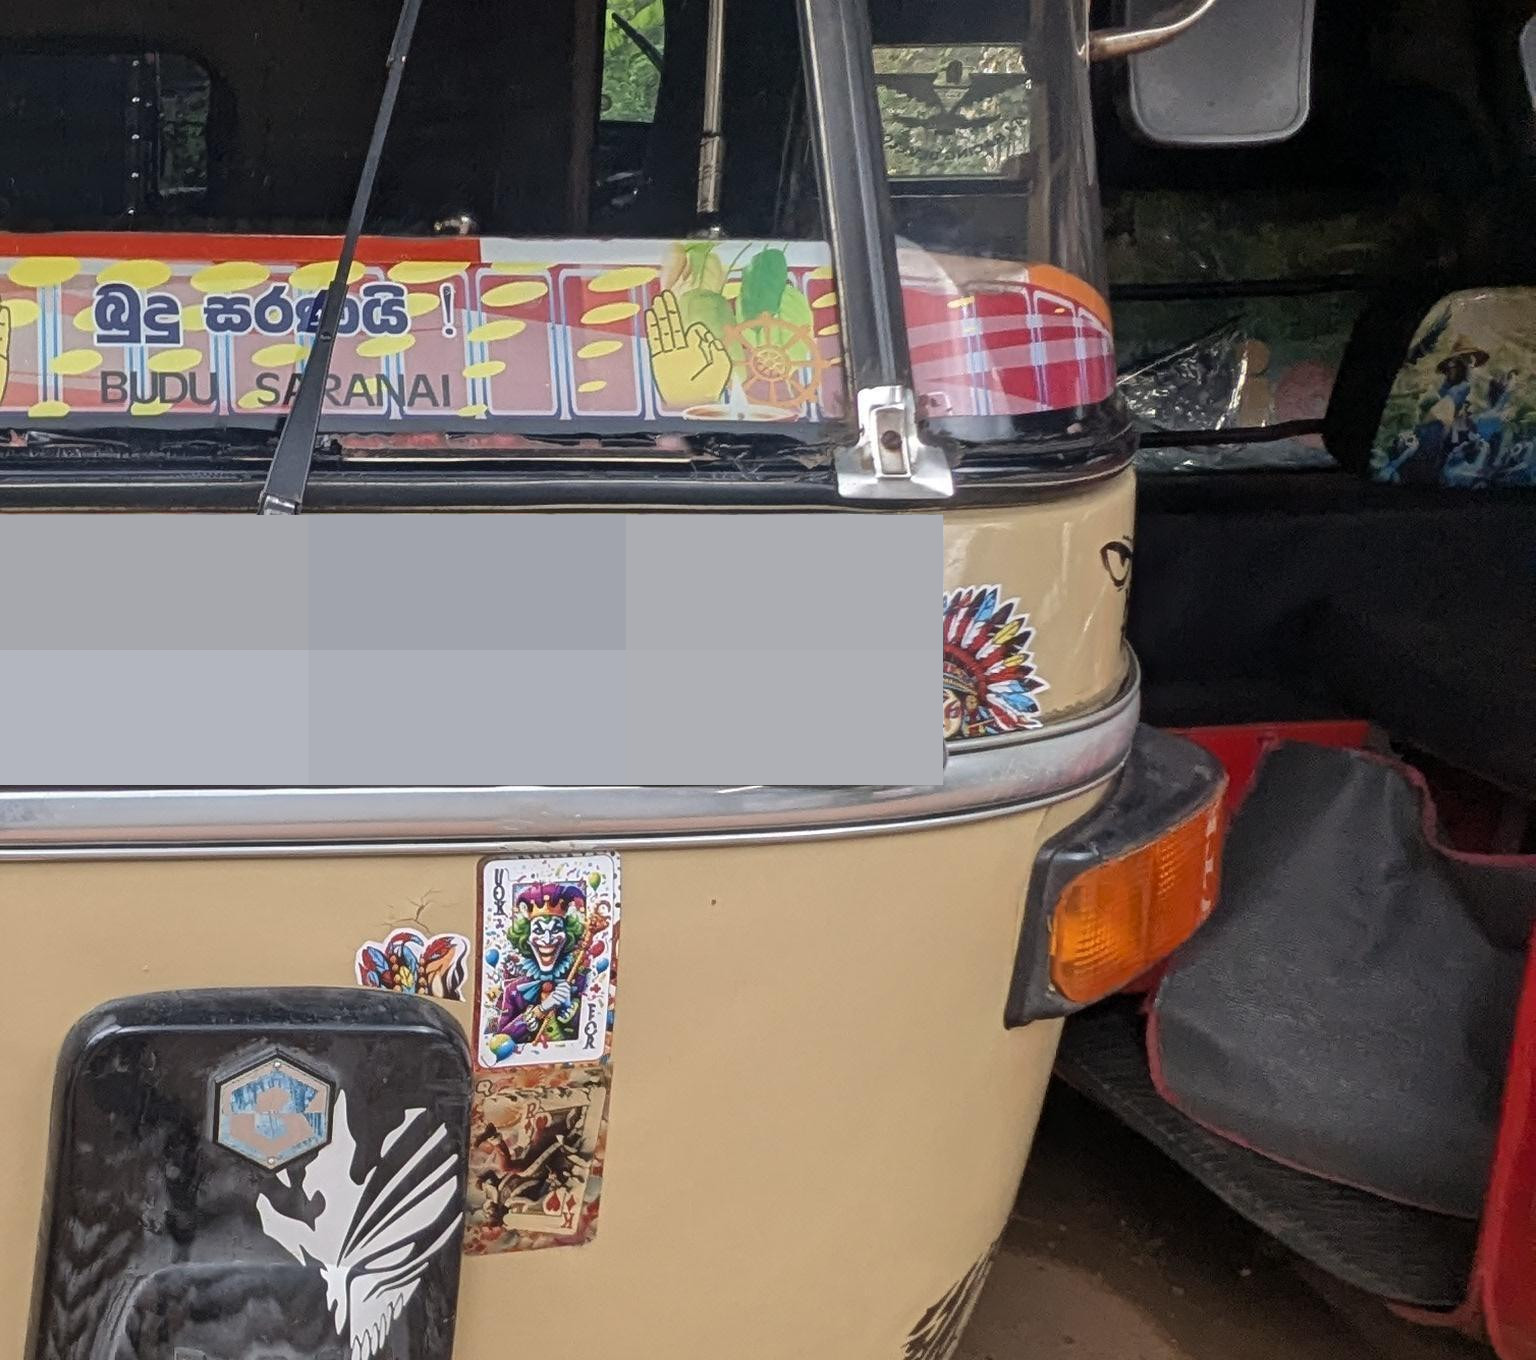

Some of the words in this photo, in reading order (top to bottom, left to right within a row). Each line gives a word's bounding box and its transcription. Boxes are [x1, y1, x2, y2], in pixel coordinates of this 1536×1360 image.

[94, 282, 182, 345] බුදු
[100, 370, 217, 406] BUDU
[256, 372, 451, 408] SARANAI
